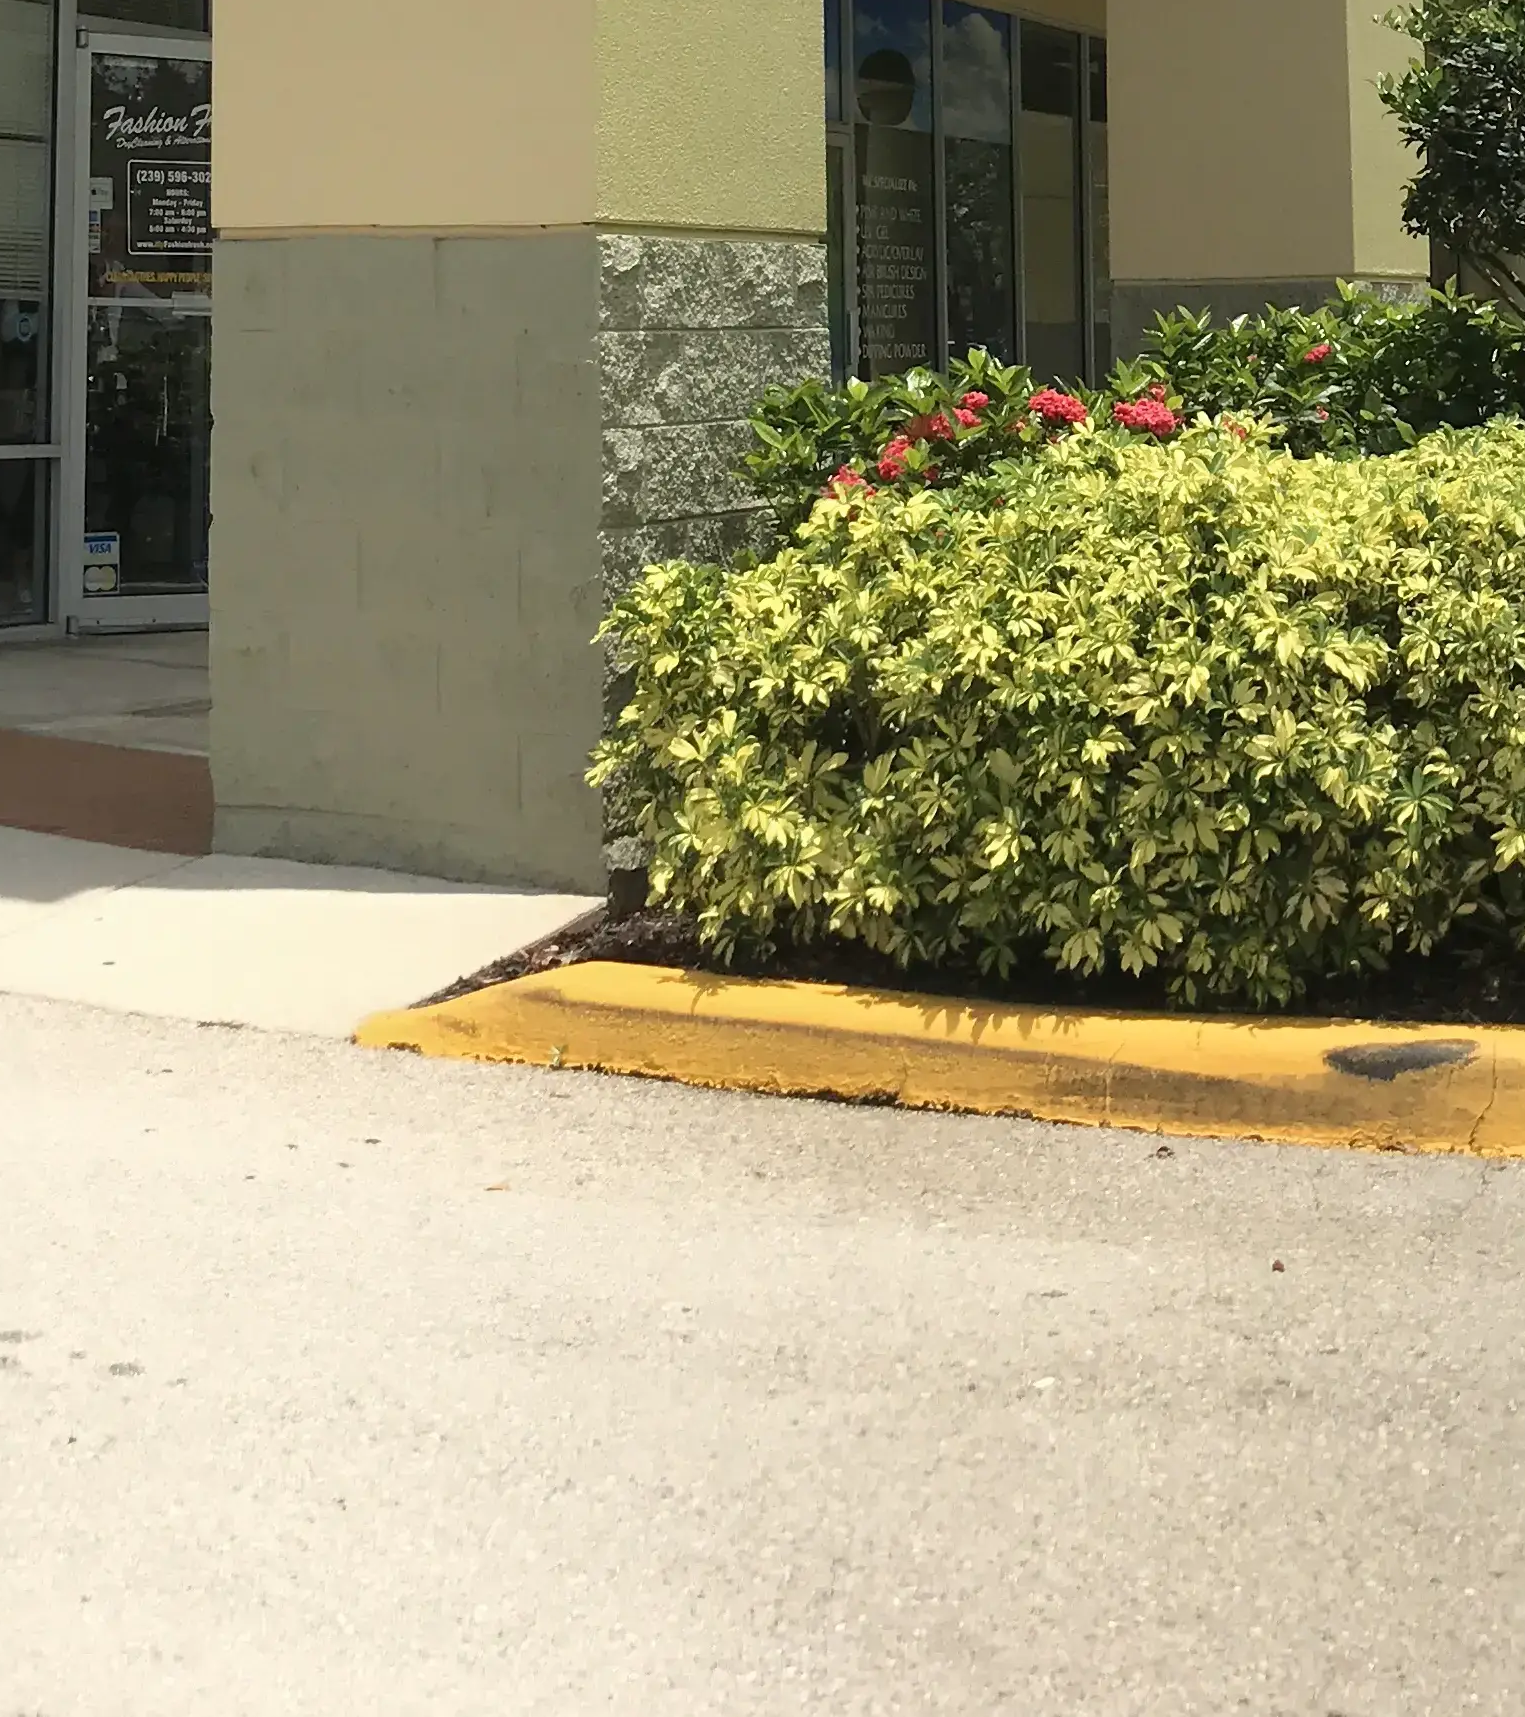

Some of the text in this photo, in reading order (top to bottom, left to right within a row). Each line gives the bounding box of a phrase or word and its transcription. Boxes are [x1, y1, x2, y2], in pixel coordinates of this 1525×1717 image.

[103, 104, 212, 140] Fashion F
[136, 170, 212, 185] (239) 596-302
[152, 198, 177, 208] Monday
[183, 198, 204, 208] Friday
[894, 343, 927, 359] POWDER
[89, 542, 112, 554] VISA
